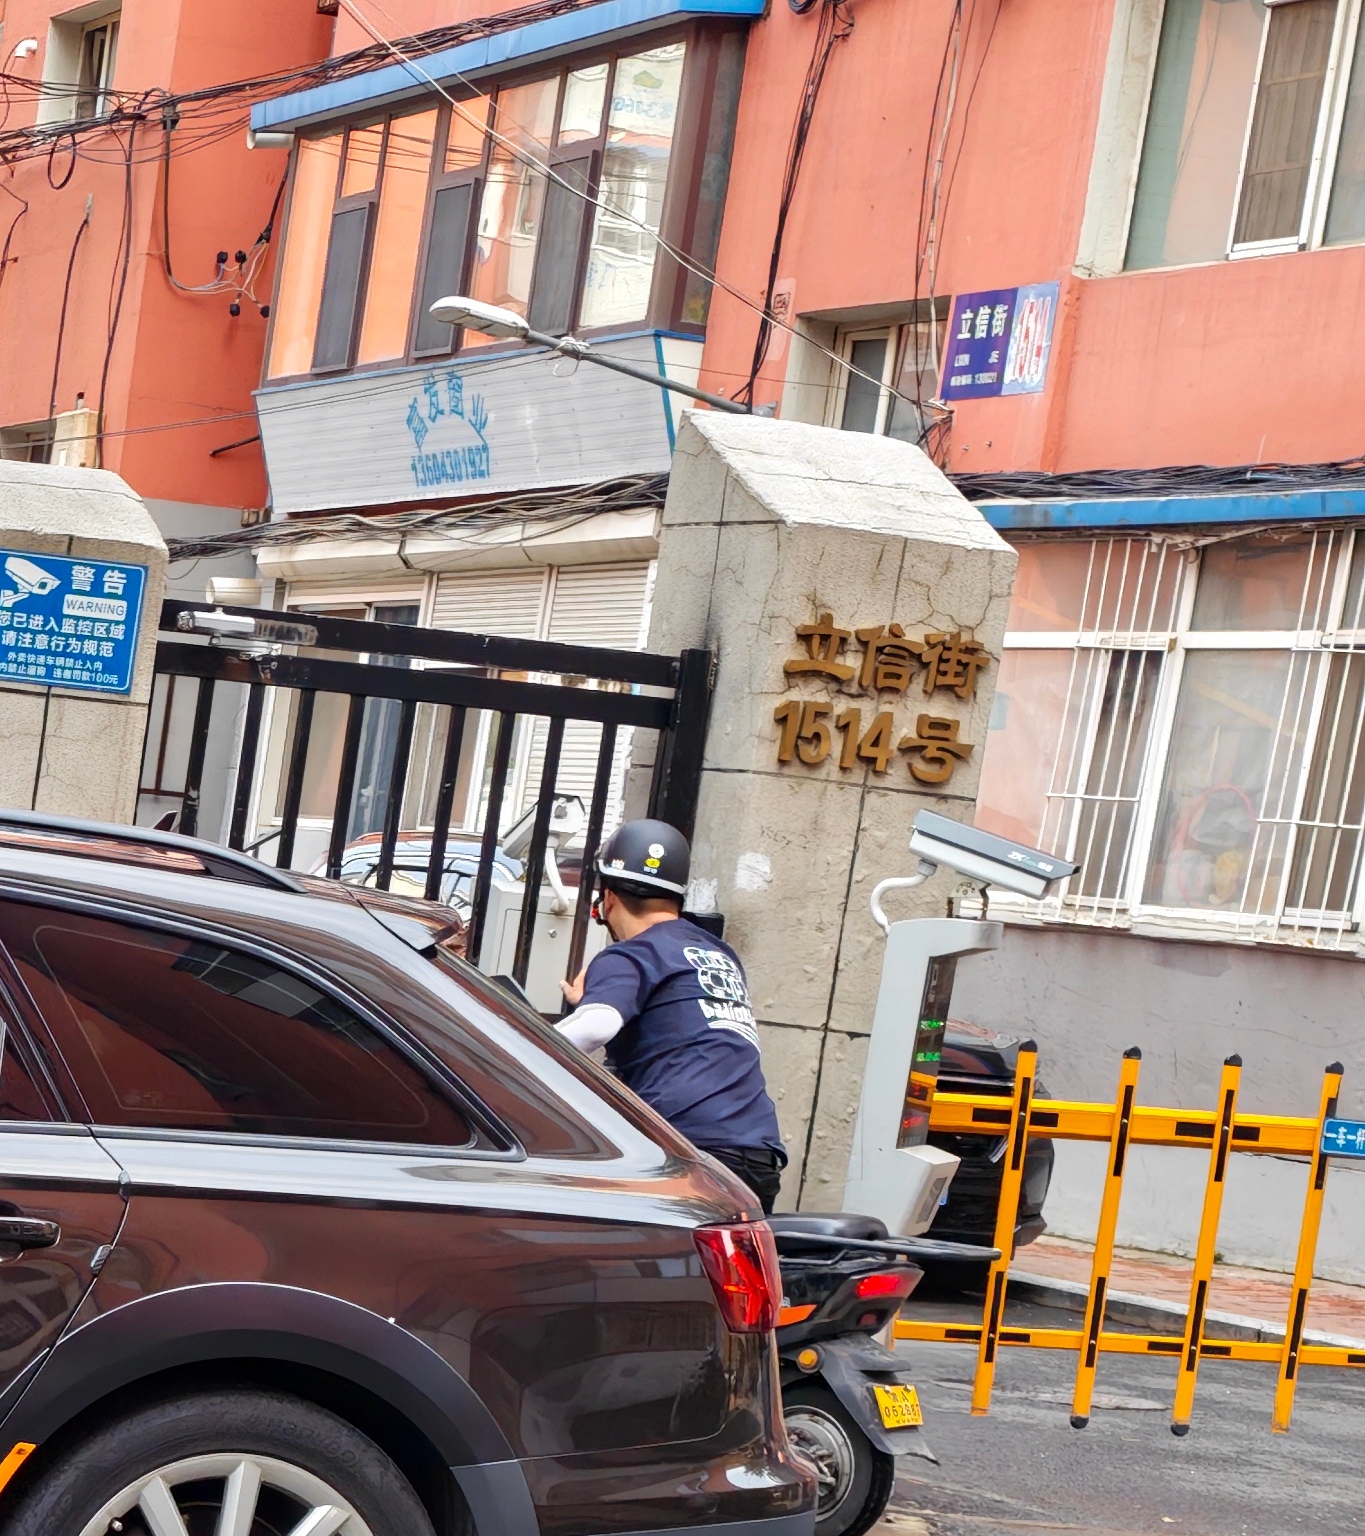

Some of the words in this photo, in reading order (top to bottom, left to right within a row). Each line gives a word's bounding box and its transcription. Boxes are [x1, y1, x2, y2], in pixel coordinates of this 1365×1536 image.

[957, 303, 1009, 340] 立信街
[71, 565, 127, 596] 警告
[65, 599, 125, 617] WARNING
[1, 630, 115, 658] 请注意行为规范
[783, 612, 991, 699] 立信街
[773, 700, 975, 784] 1514号
